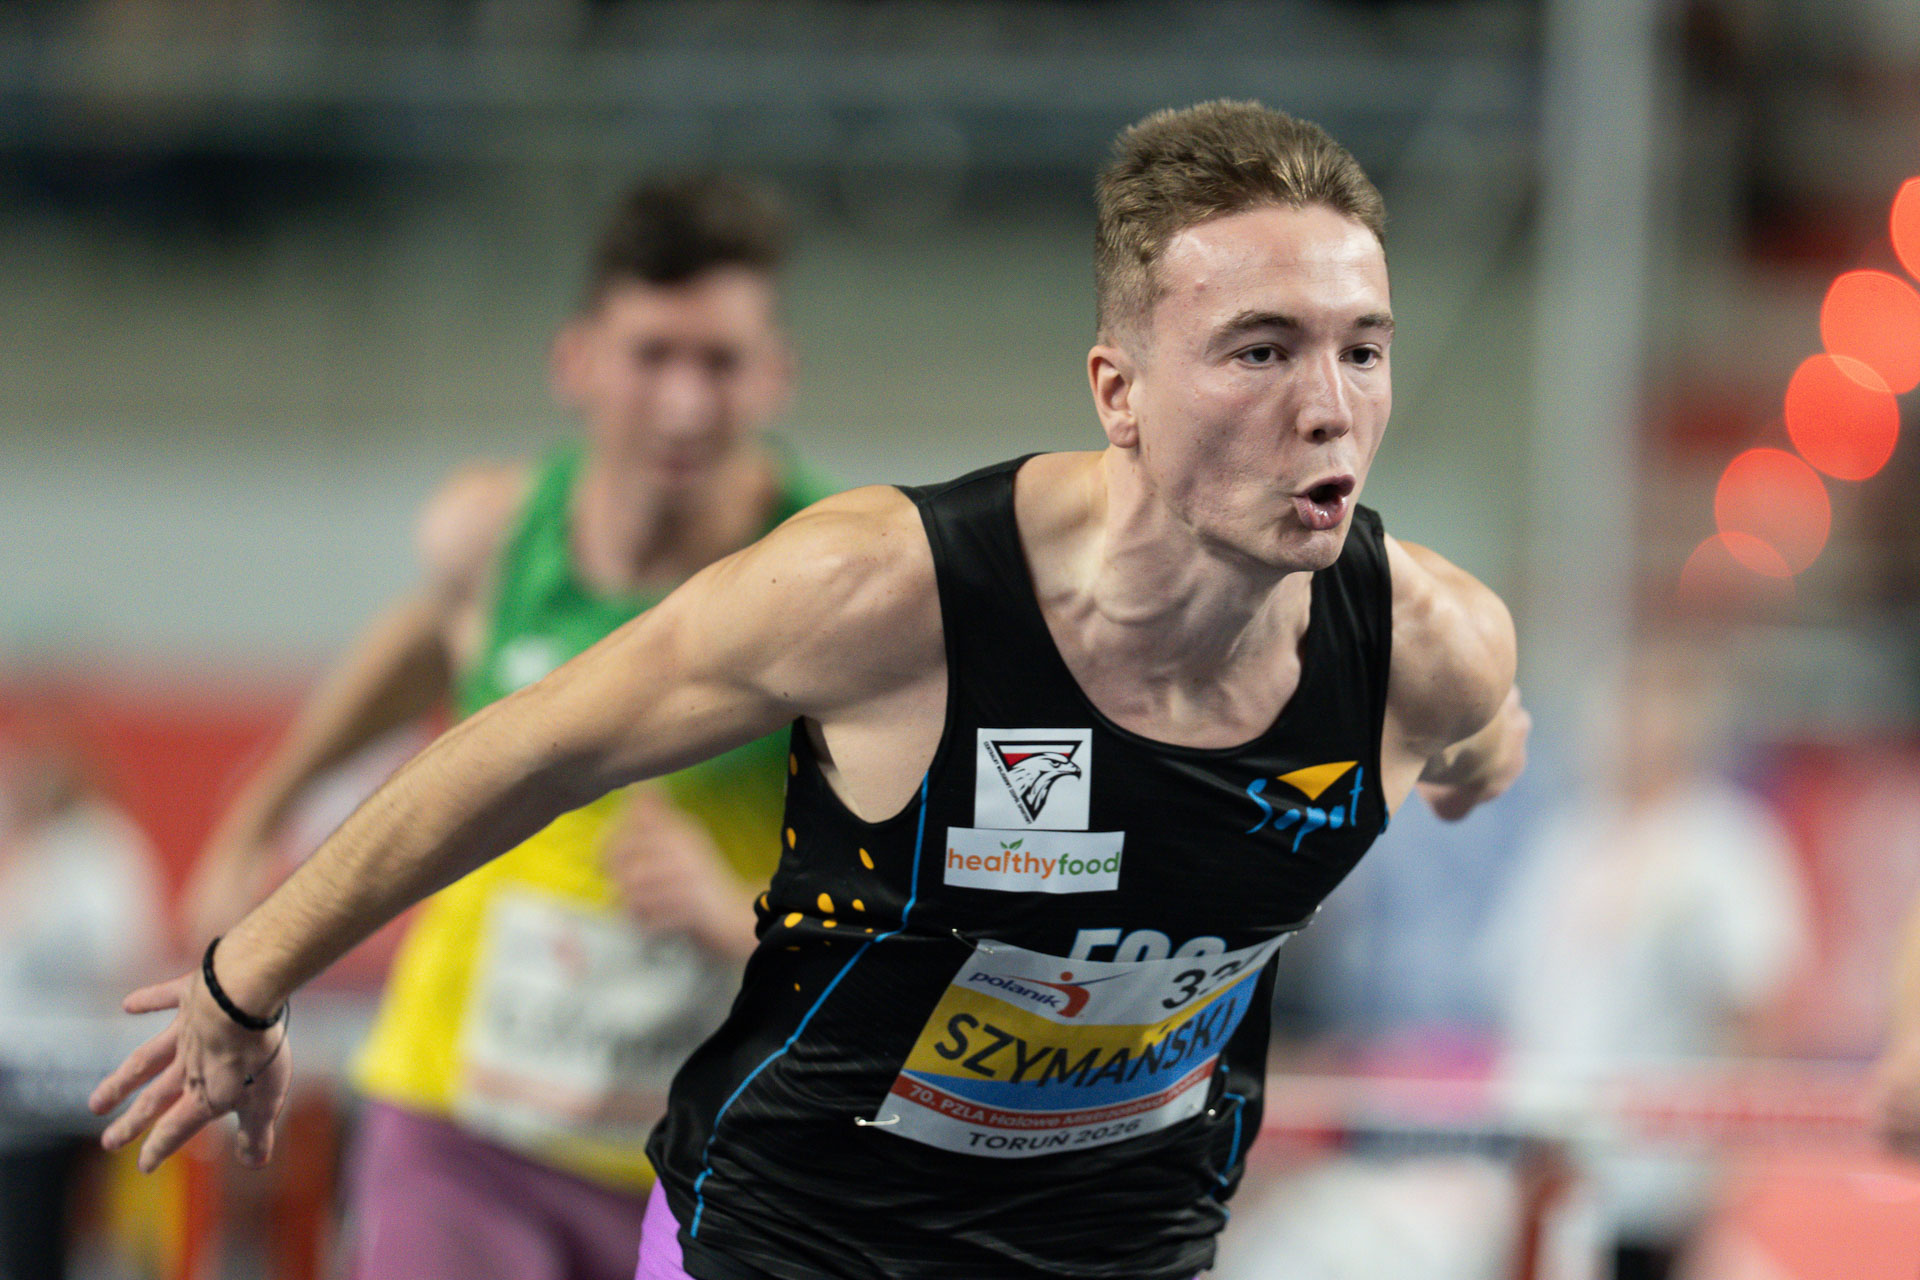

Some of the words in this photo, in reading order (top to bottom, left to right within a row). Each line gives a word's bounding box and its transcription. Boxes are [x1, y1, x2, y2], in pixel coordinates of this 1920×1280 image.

[1245, 766, 1363, 853] Sopot
[948, 848, 1120, 879] healthyfood
[968, 972, 1060, 1008] polanik
[934, 997, 1236, 1088] SZYMAŃSKI
[909, 1084, 936, 1106] 70.
[969, 1129, 1069, 1150] TORUŃ
[1074, 1118, 1142, 1142] 2026
